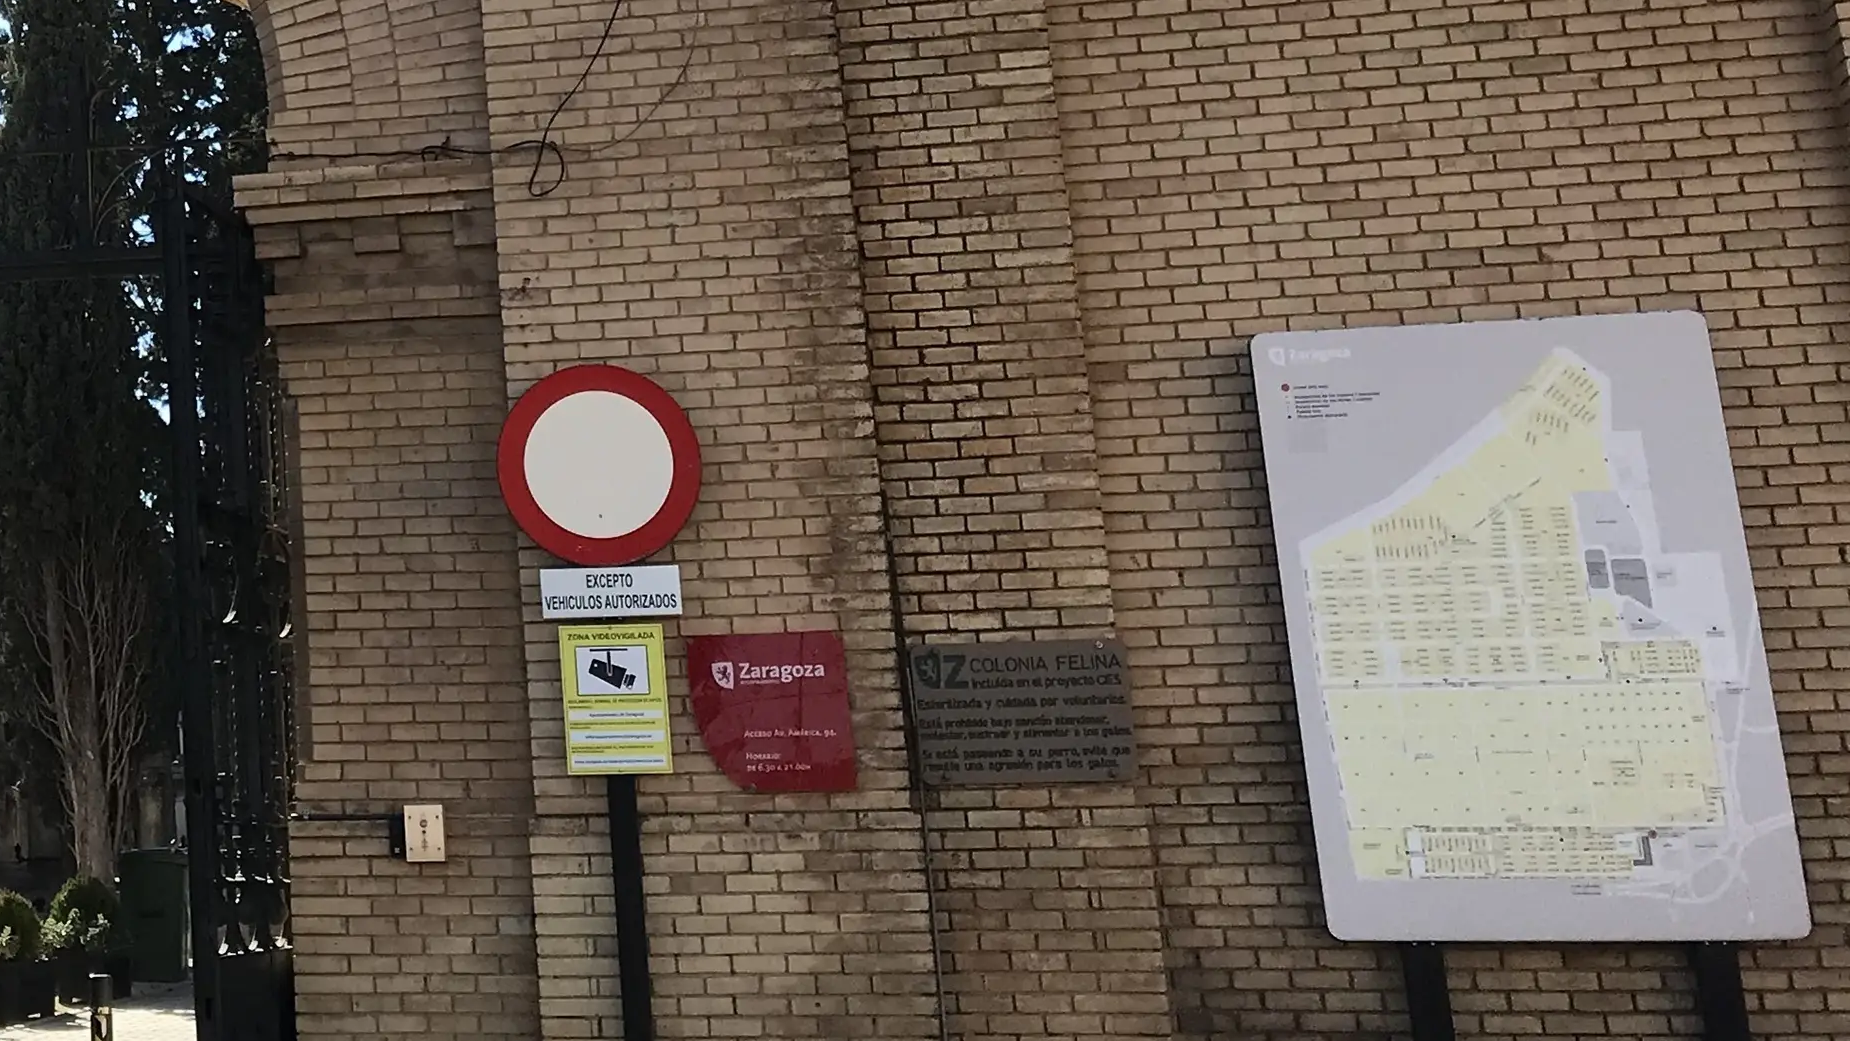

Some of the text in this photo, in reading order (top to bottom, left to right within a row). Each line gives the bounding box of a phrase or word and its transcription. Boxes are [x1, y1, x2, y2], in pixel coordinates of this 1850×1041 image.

[585, 573, 633, 588] EXCEPTO
[545, 593, 677, 610] VEHICULOS AUTORIZADOS
[567, 631, 656, 641] ZONA VIDEOVIGILADA
[969, 653, 1122, 673] COLONIA FELINA
[738, 662, 825, 683] Zaragoza
[1017, 679, 1030, 689] en
[1032, 677, 1044, 688] el
[1046, 675, 1096, 689] proyecto
[986, 700, 992, 710] y
[1040, 697, 1058, 708] por
[1013, 729, 1020, 740] y
[1083, 726, 1100, 737] los
[1016, 749, 1024, 758] a
[1111, 747, 1131, 757] que
[1066, 758, 1084, 769] los
